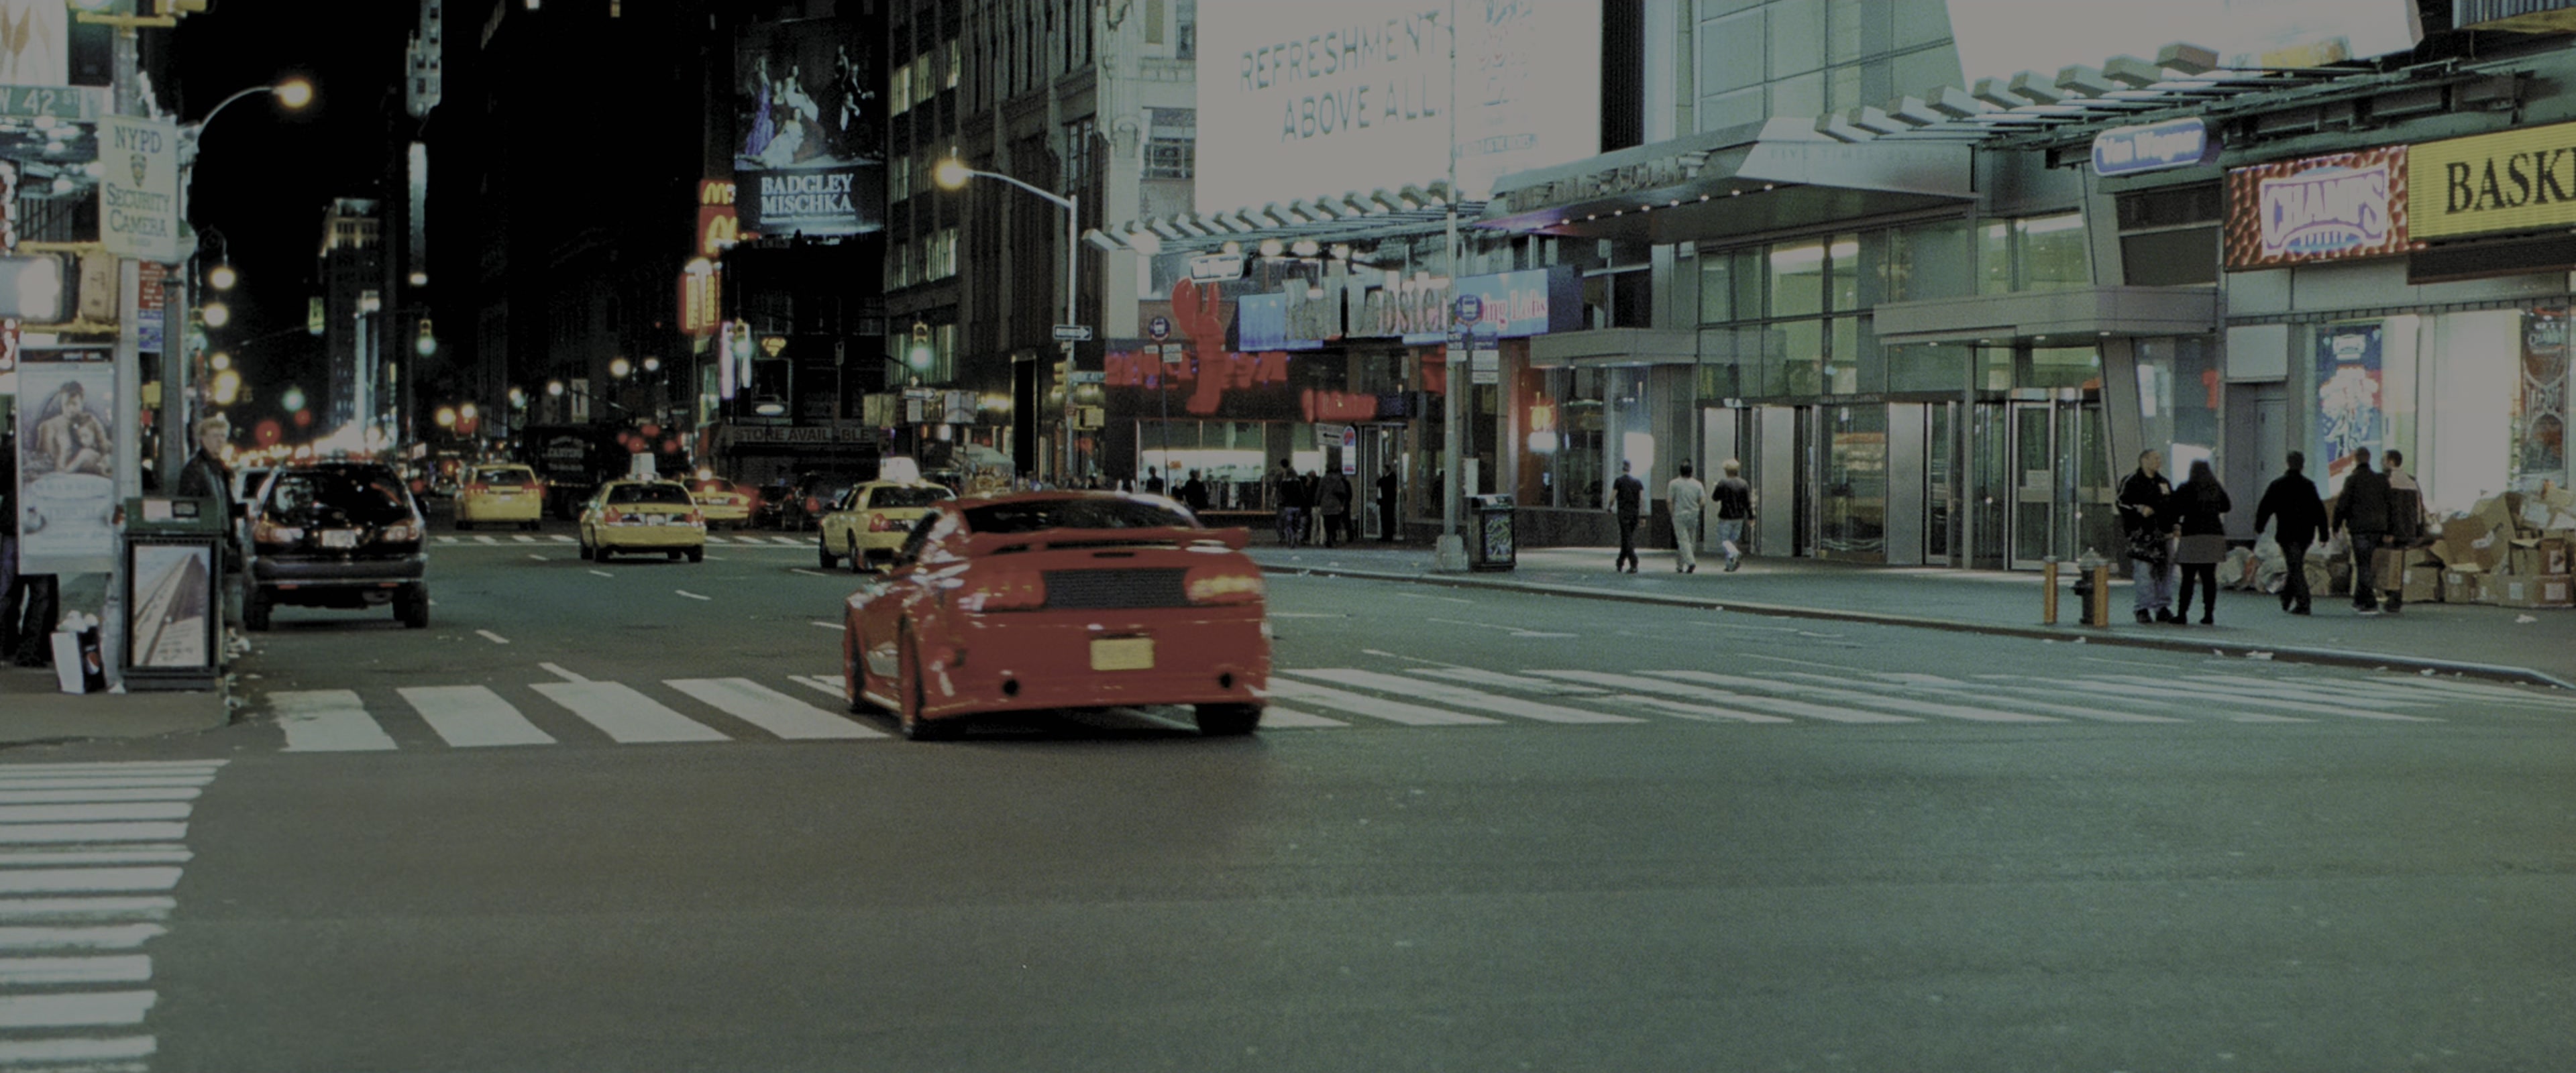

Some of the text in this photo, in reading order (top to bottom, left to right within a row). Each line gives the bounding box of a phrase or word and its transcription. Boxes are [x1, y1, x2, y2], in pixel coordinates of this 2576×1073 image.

[1240, 10, 1440, 93] REFRESHMENT
[23, 89, 56, 115] 42
[62, 89, 80, 105] ST
[1281, 73, 1442, 144] ABOVE ALL.
[114, 125, 162, 154] NYPD
[760, 174, 855, 195] BADGLEY
[2445, 146, 2576, 215] BASK
[107, 182, 170, 213] SECURITY
[760, 192, 855, 216] MISCHKA
[2265, 171, 2386, 251] CHAMPS
[110, 209, 168, 237] CAMERA
[787, 427, 870, 442] AVAILBLE
